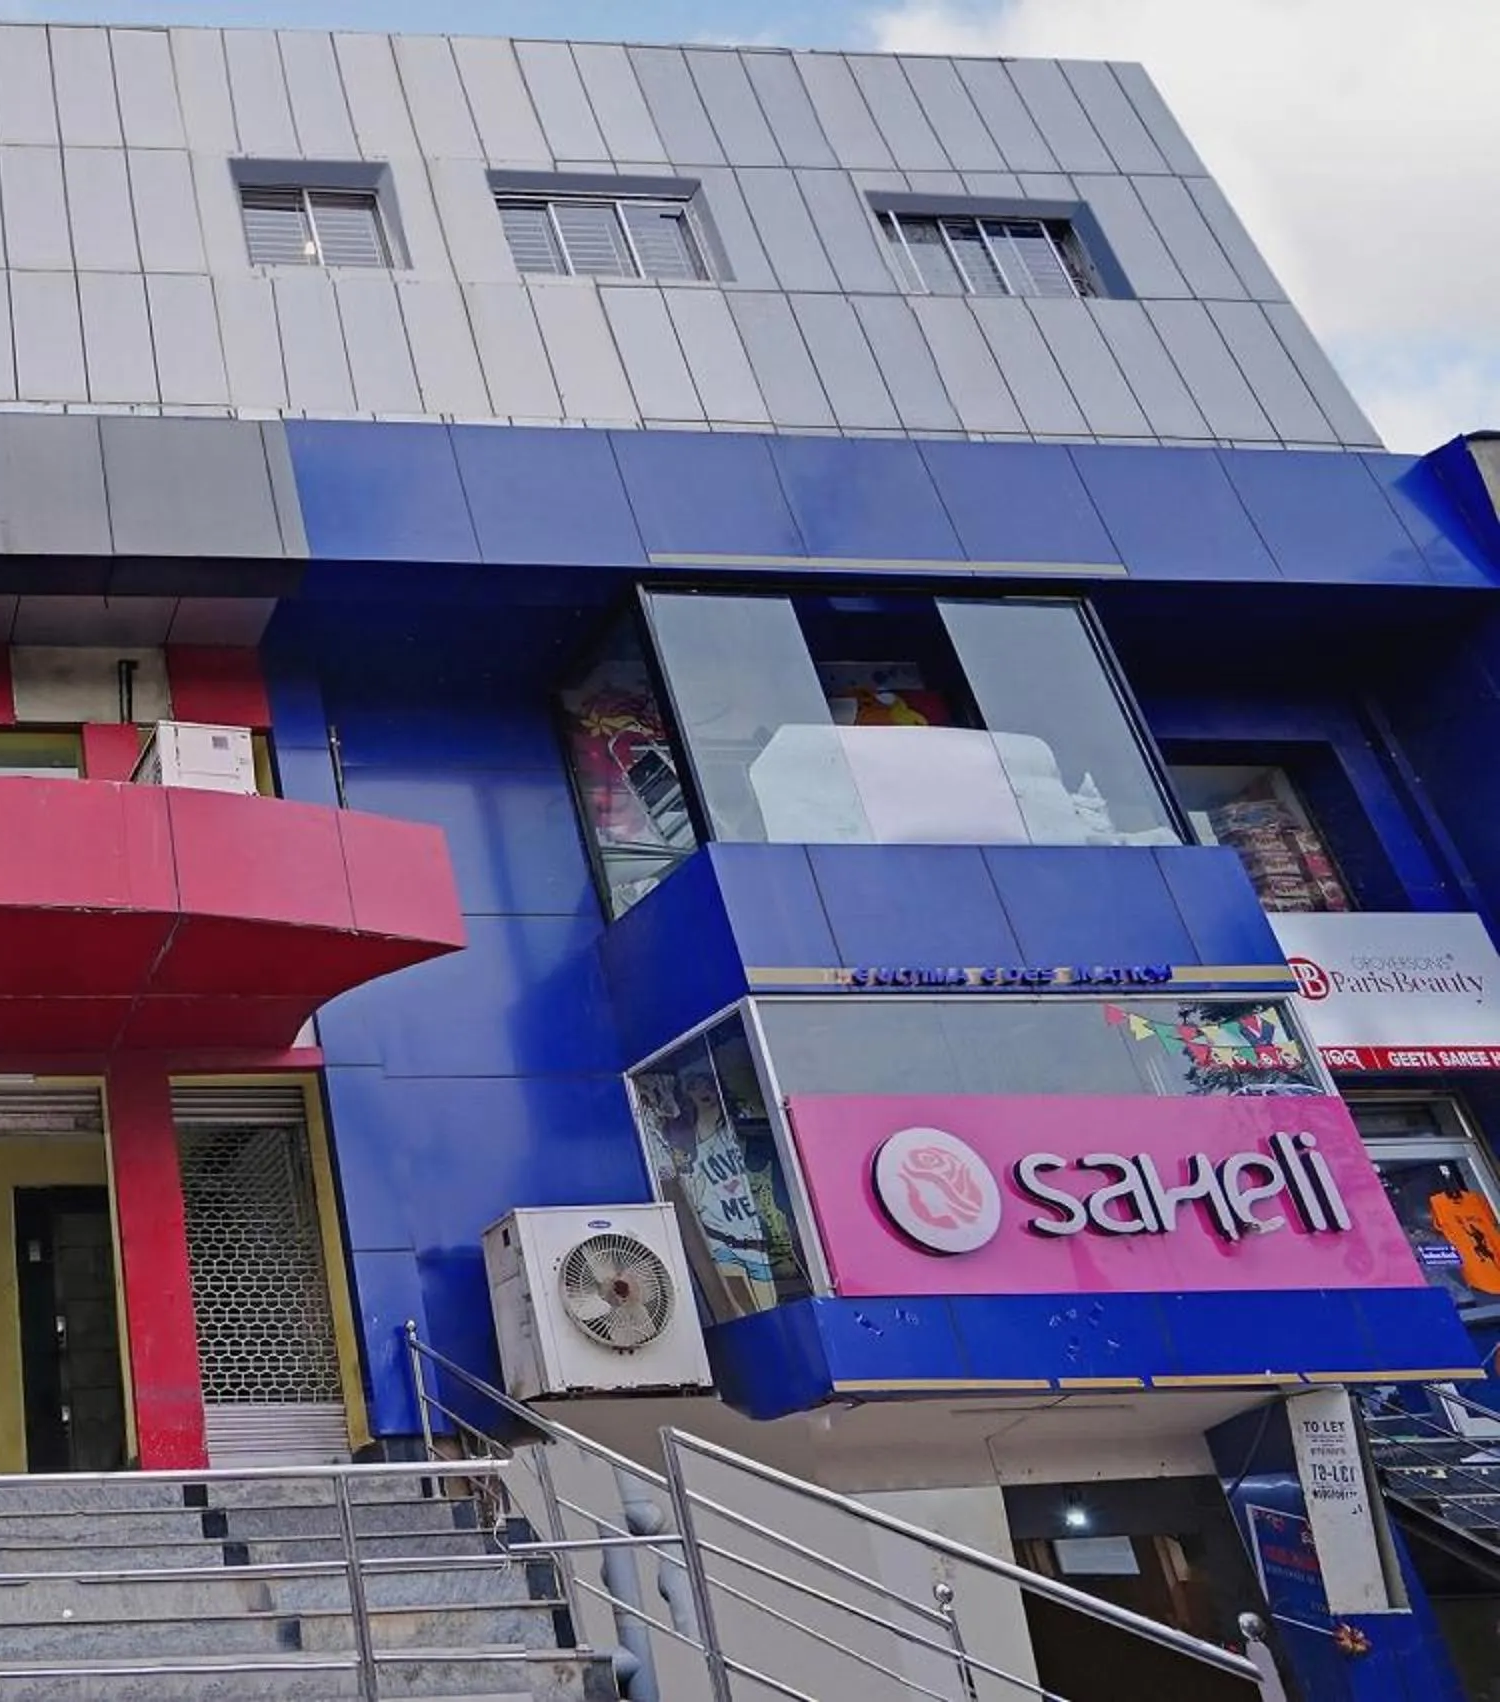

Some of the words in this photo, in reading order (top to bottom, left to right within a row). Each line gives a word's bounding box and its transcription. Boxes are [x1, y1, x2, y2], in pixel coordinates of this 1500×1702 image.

[1387, 1051, 1440, 1067] GEETA
[1440, 1051, 1489, 1067] SAREE
[719, 1196, 757, 1222] ME
[1303, 1421, 1319, 1433] TO
[1323, 1421, 1345, 1433] LET
